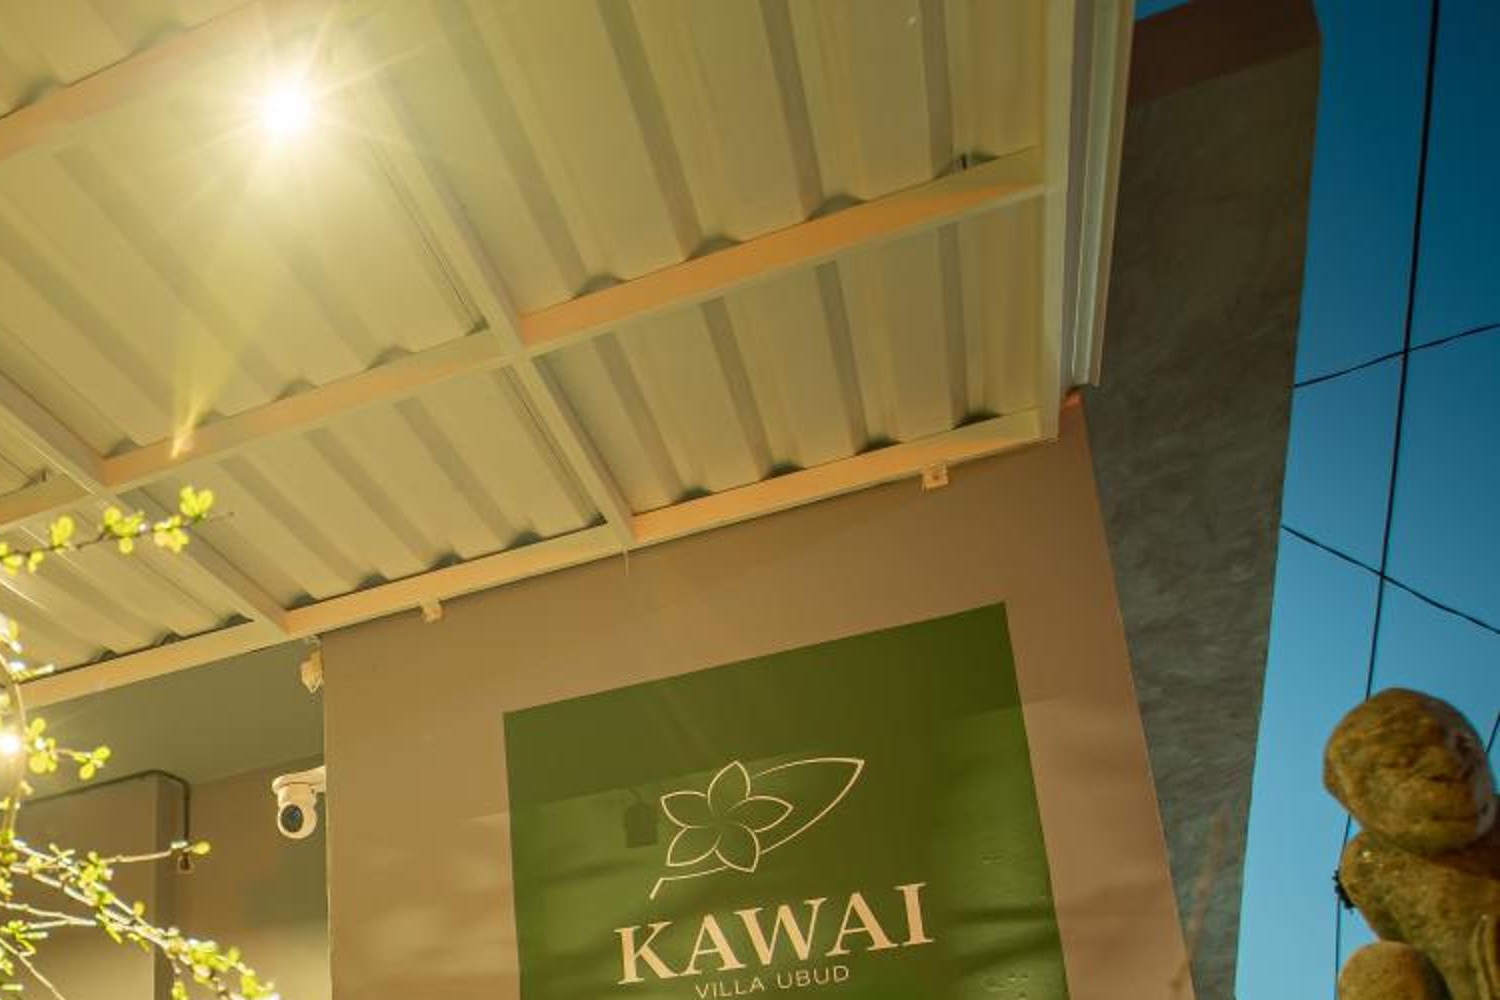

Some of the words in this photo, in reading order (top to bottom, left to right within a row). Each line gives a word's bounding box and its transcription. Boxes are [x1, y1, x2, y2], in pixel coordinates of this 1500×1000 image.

[614, 881, 936, 985] KAWAI
[695, 976, 766, 999] VILLA
[776, 965, 850, 989] UBUD
